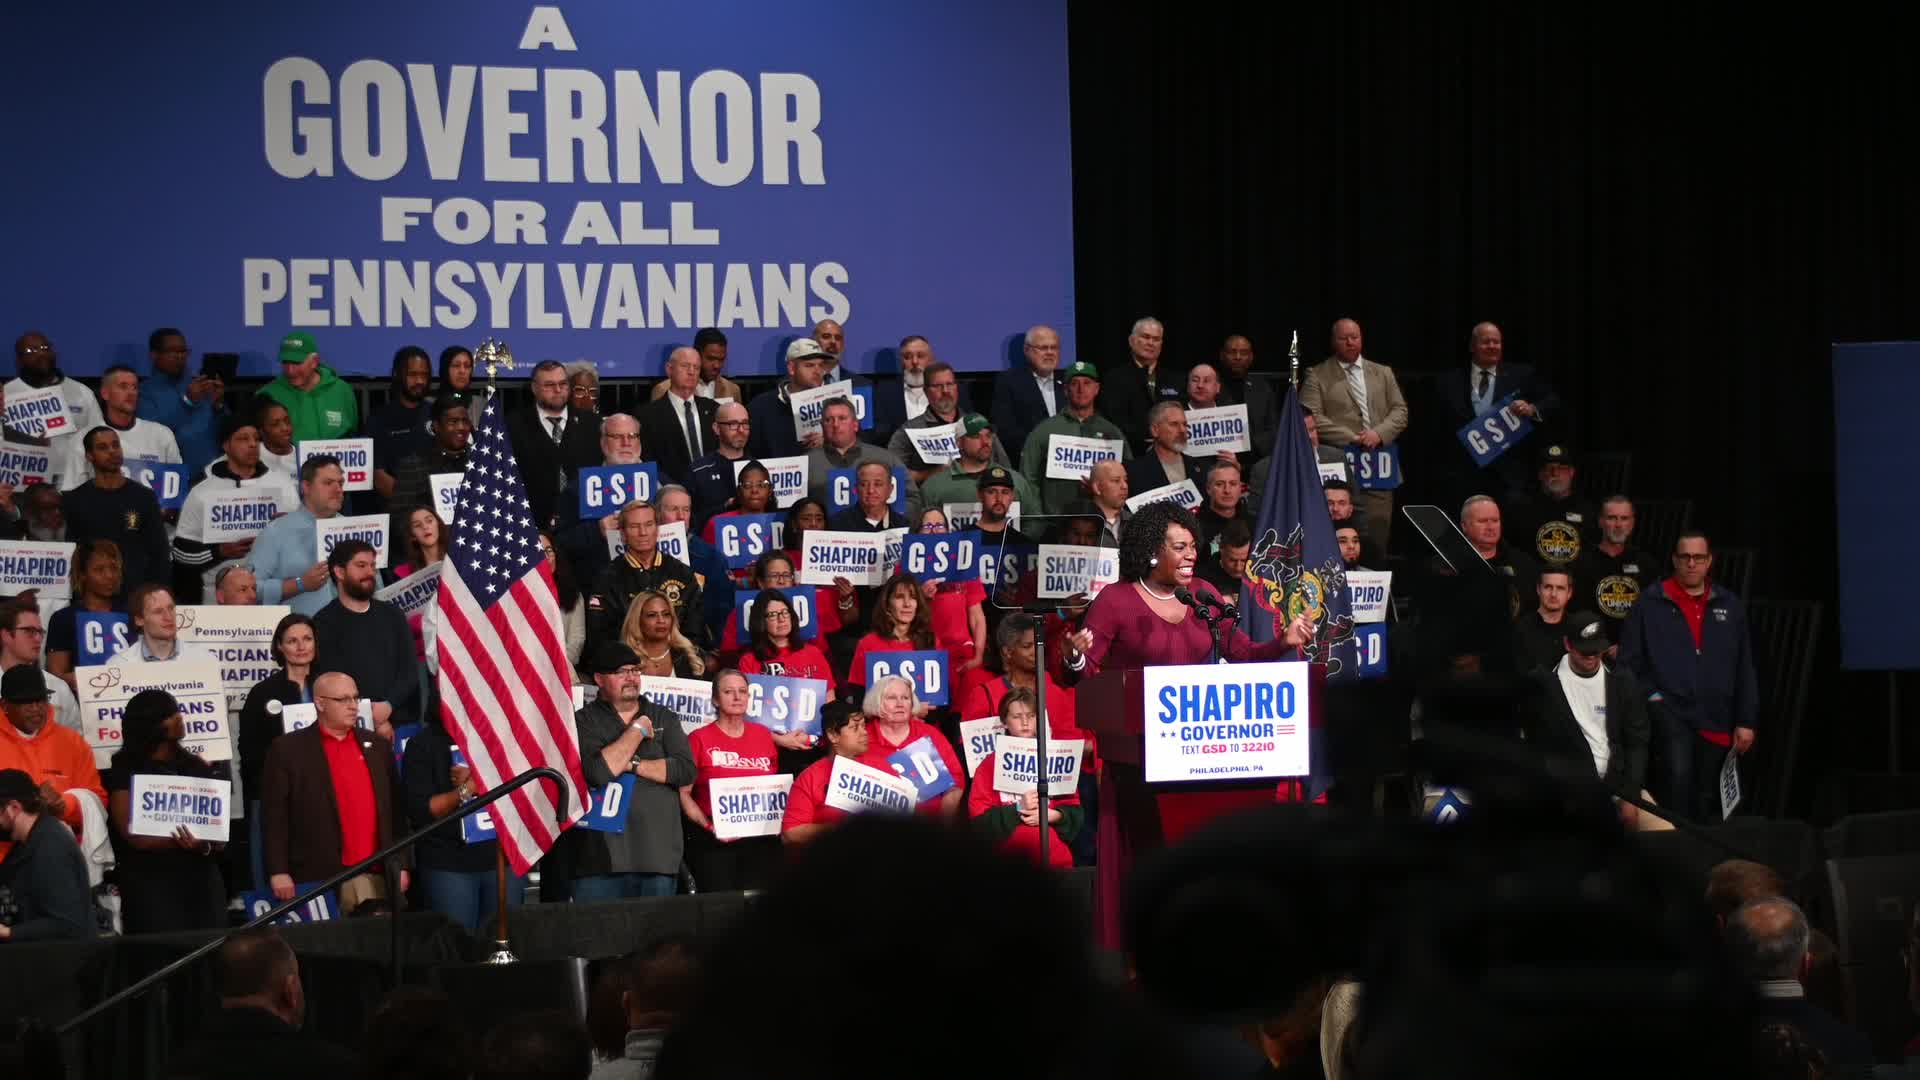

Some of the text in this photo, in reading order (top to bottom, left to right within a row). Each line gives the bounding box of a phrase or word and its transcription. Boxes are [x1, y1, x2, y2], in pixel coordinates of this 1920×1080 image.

[520, 5, 578, 51] A
[263, 56, 827, 186] GOVERNOR
[381, 197, 719, 246] FOR ALL
[243, 258, 850, 330] PENNSYLVANIANS
[15, 418, 45, 437] AVIS
[917, 438, 957, 452] SHAPI
[1194, 436, 1235, 446] GOVERNOR
[0, 453, 48, 473] APIRO
[586, 471, 649, 507] GSD
[211, 503, 277, 522] SHAPIRO
[810, 546, 877, 565] SHAPIRO
[909, 540, 973, 574] GSD
[819, 565, 866, 573] GOVERNOR
[1046, 556, 1112, 576] SHAPIRO
[4, 576, 54, 585] GOVERNOR
[1046, 576, 1088, 592] DAVIS
[85, 620, 130, 654] GS
[195, 627, 273, 639] Pennsylvania
[748, 683, 817, 721] GSD
[1158, 681, 1295, 724] SHAPIRO
[98, 728, 121, 741] Fo
[1181, 723, 1274, 741] GOVERNOR
[1181, 742, 1275, 755] TEXT GSD TO 32210
[1002, 752, 1075, 774] SHAIRO
[142, 791, 222, 816] SHAPIRO
[718, 791, 787, 815] SHAPIRO
[154, 813, 209, 825] GOVERNOR
[730, 812, 780, 824] GOVERNOR
